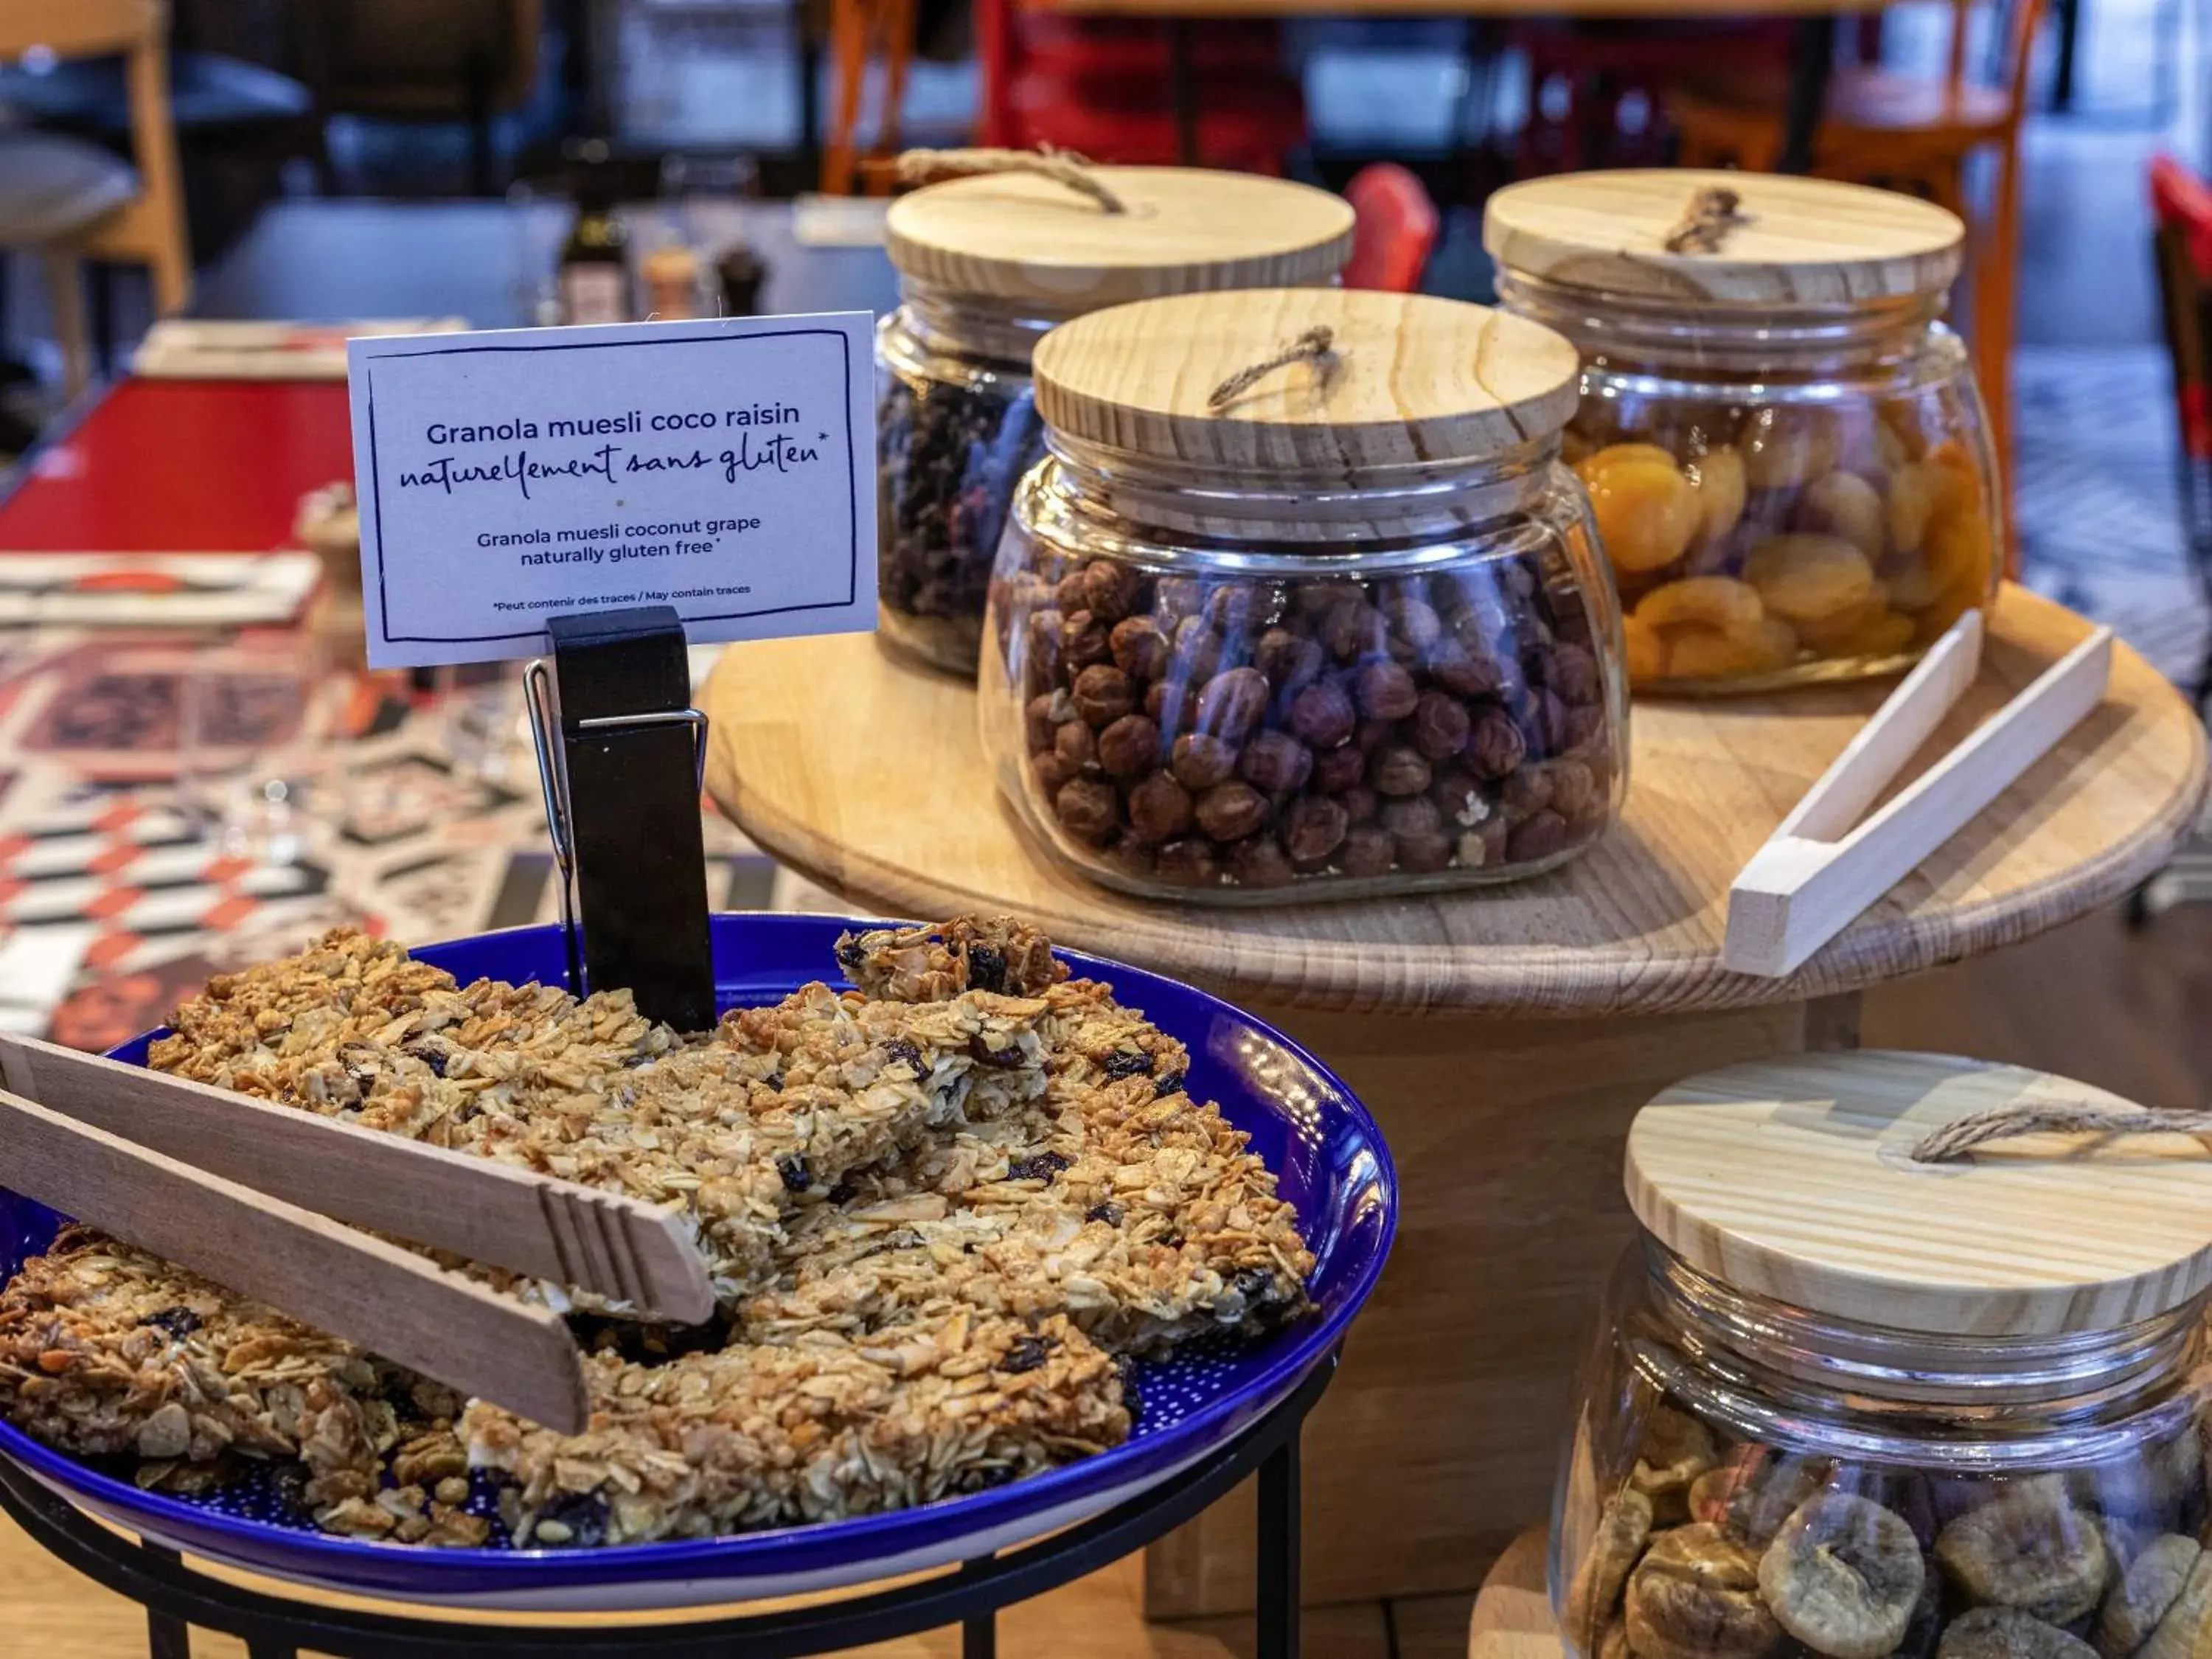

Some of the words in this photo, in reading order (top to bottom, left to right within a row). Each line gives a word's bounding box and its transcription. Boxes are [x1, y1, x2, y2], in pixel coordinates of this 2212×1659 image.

[426, 420, 538, 445] Granola
[548, 410, 642, 439] muesli
[650, 413, 717, 432] coco
[725, 403, 800, 428] raisin
[400, 443, 623, 501] naturellement
[625, 451, 713, 473] sans
[477, 529, 552, 548] Granola
[555, 524, 620, 543] muesli
[625, 519, 702, 540] coconut
[706, 518, 762, 543] grape
[520, 545, 605, 566] naturally
[608, 543, 671, 563] gluten
[527, 597, 575, 610] contenir
[577, 597, 600, 606] des
[600, 594, 637, 605] traces
[638, 591, 644, 602] /
[644, 591, 669, 602] May
[669, 586, 714, 599] contain
[715, 585, 752, 596] traces
